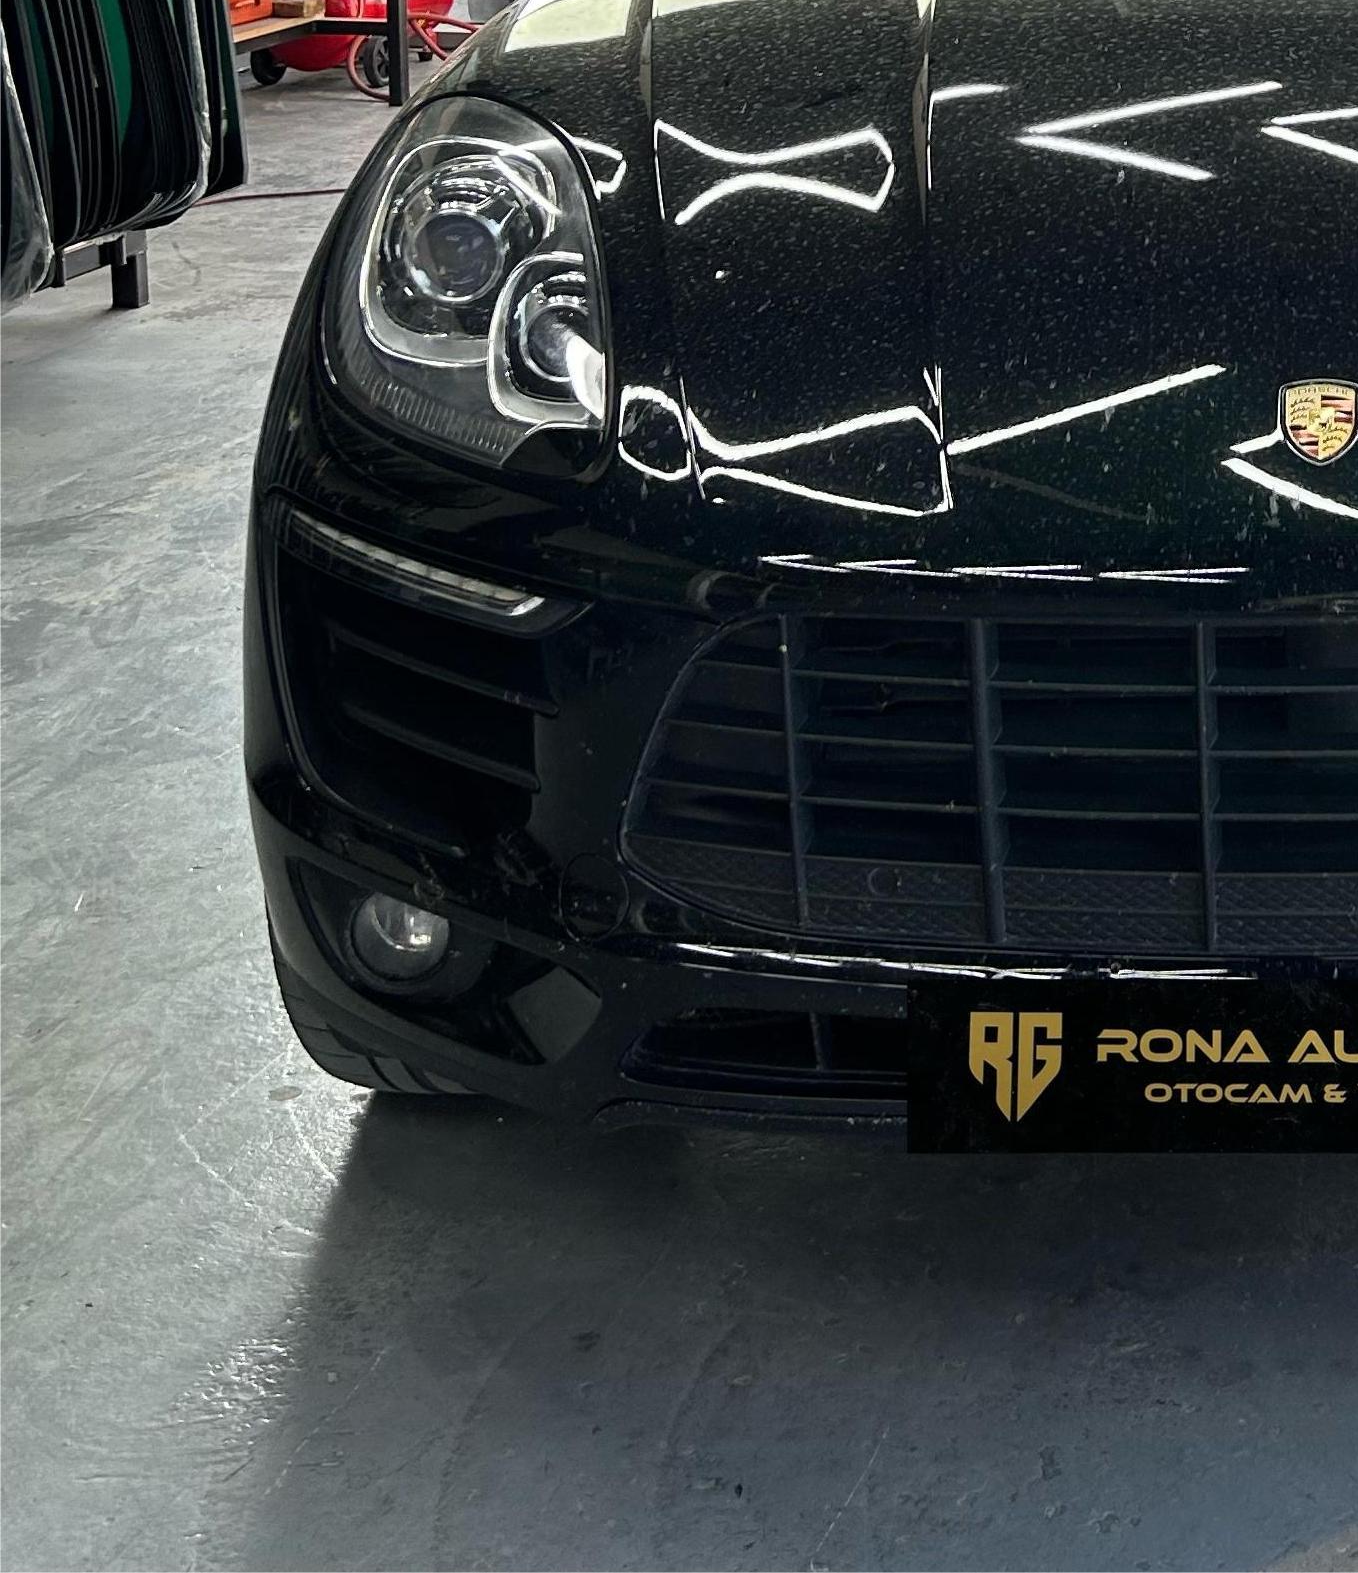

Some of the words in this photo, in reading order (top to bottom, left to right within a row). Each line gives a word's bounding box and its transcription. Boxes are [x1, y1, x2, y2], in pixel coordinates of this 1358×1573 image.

[1096, 1028, 1270, 1063] RONA
[968, 1011, 1063, 1122] RG
[1143, 1082, 1313, 1104] OTOCAM
[1323, 1082, 1346, 1104] &
